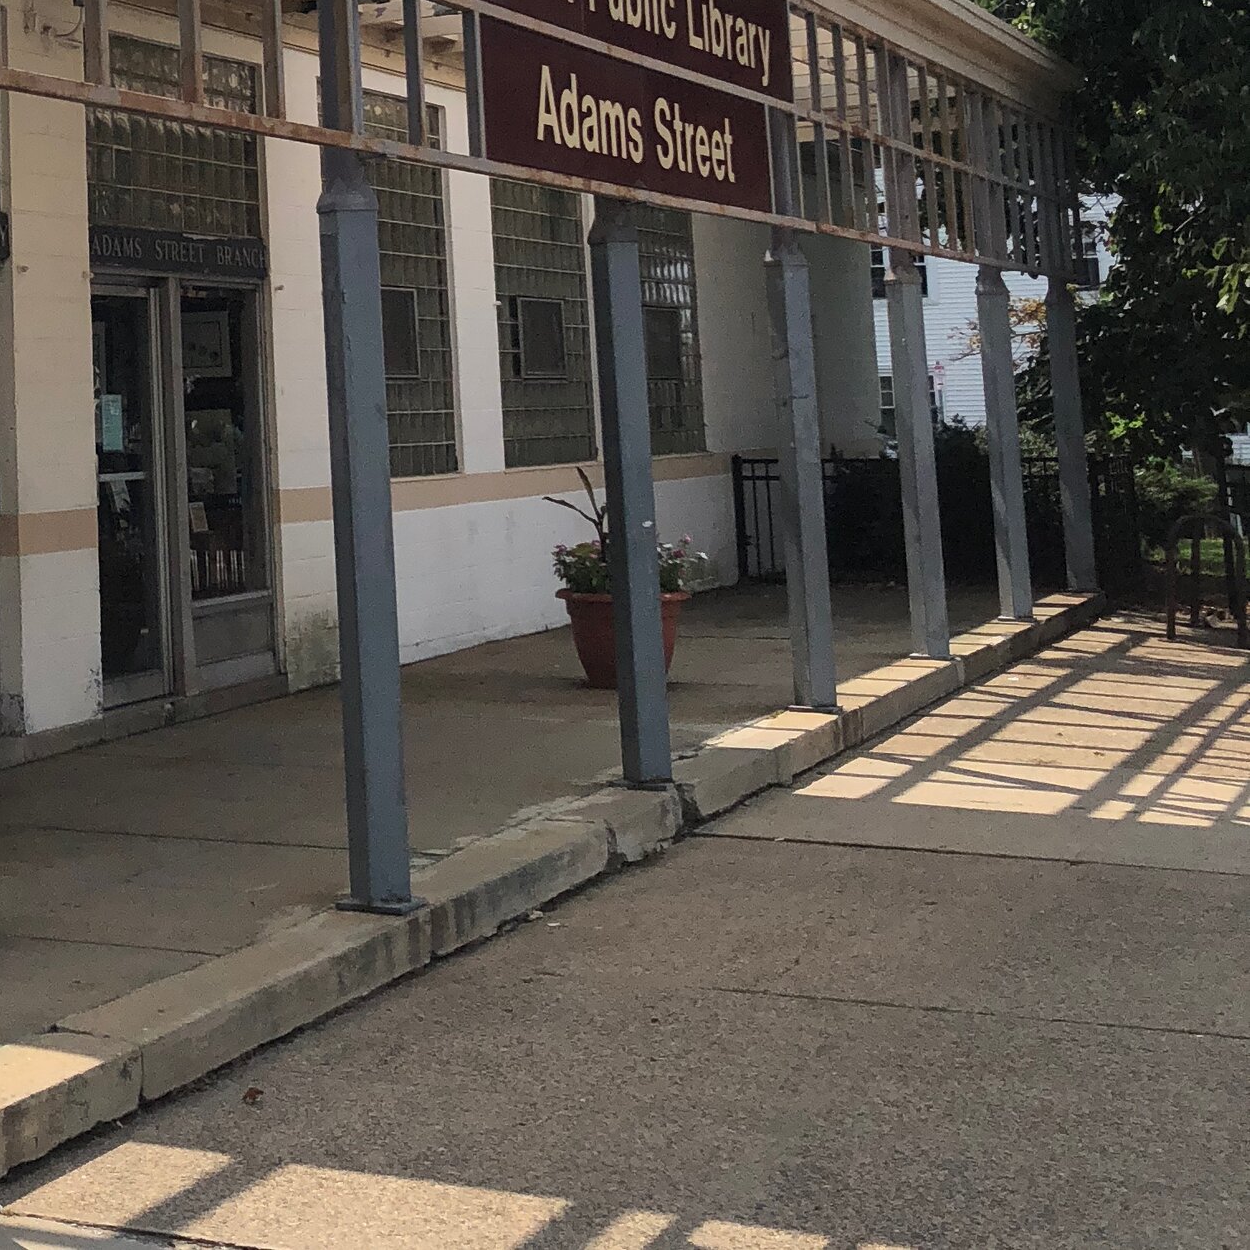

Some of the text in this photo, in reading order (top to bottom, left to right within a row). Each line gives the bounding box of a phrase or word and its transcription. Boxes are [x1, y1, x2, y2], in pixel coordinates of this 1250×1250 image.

[537, 65, 735, 183] Adams Street
[91, 234, 142, 258] ADAMS
[155, 239, 204, 263] STREET
